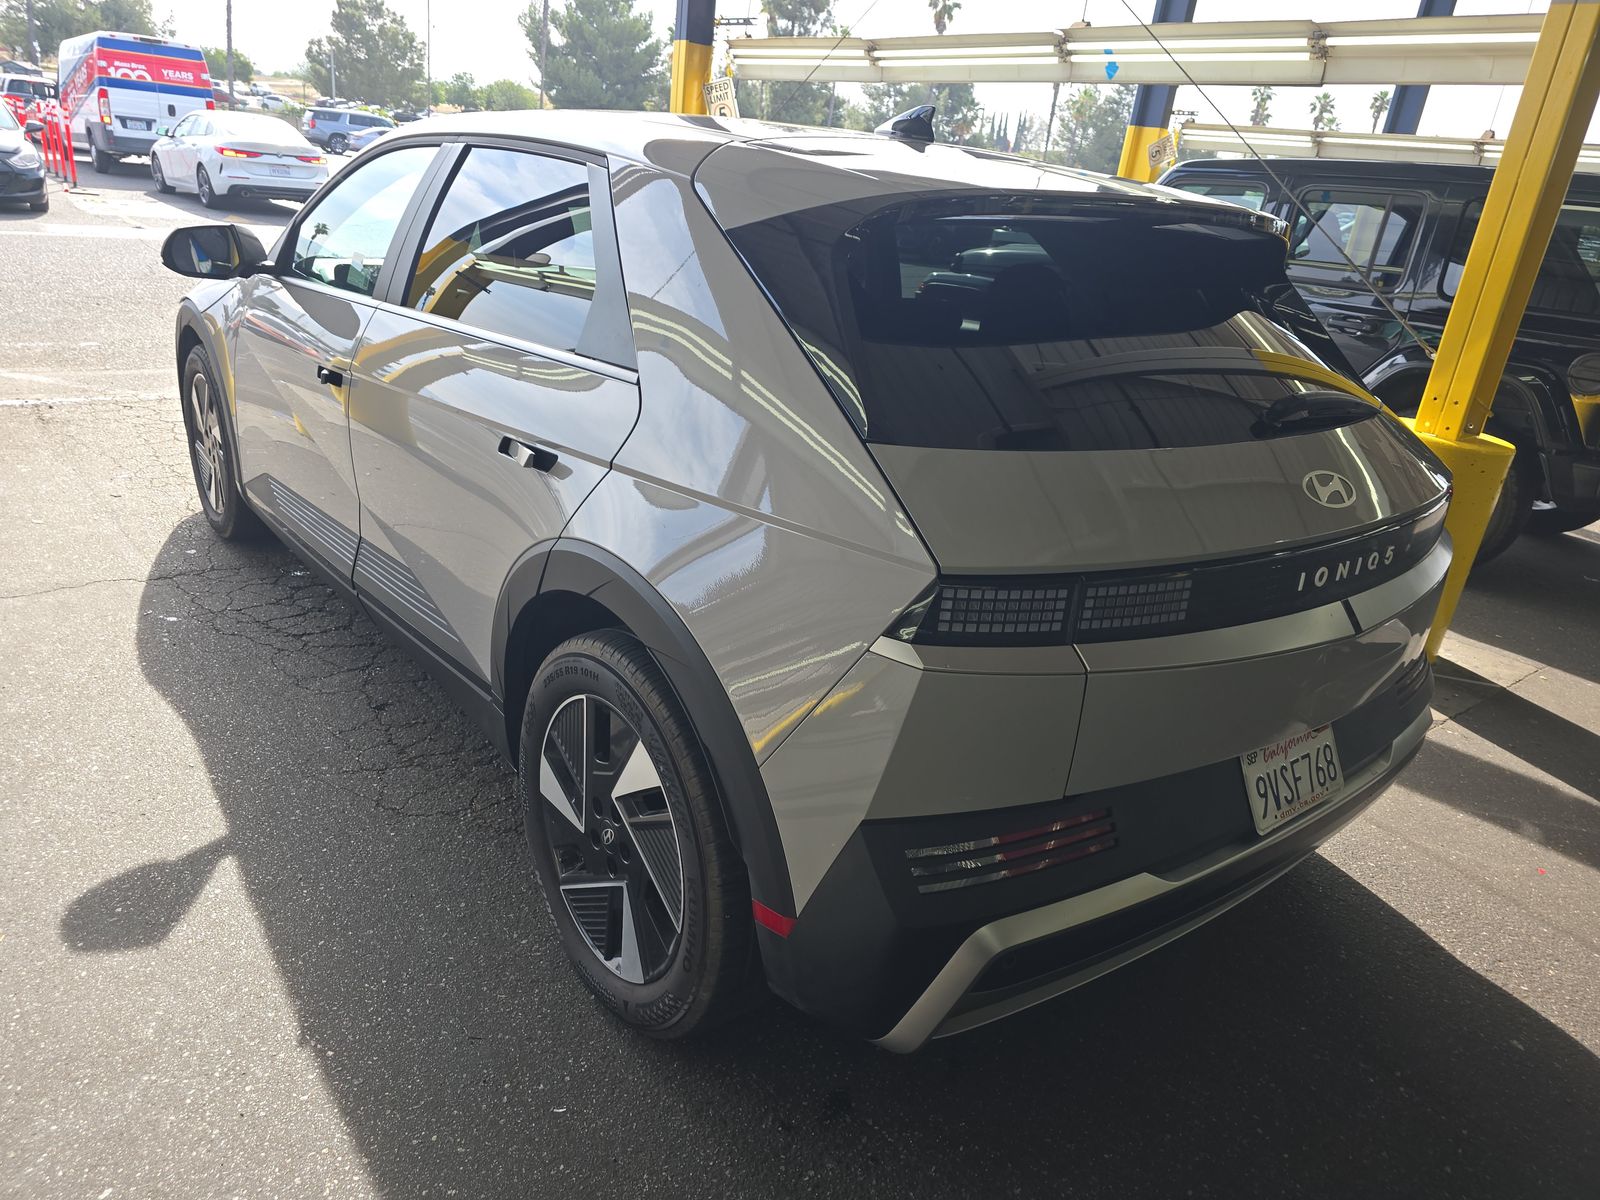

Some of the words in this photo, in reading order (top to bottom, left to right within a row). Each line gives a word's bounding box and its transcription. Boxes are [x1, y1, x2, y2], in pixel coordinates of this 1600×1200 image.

[161, 69, 194, 81] YEARS
[705, 82, 729, 96] SPEED
[710, 91, 729, 104] LIMIT
[719, 106, 727, 117] 5
[1151, 149, 1161, 158] 5
[564, 665, 578, 675] R19
[580, 667, 599, 682] 101H
[1262, 730, 1317, 764] California
[1246, 751, 1258, 766] SEP
[1255, 743, 1338, 820] 9VSF768
[1280, 789, 1326, 820] dmv.ca.gov
[682, 876, 698, 973] KUMHO
